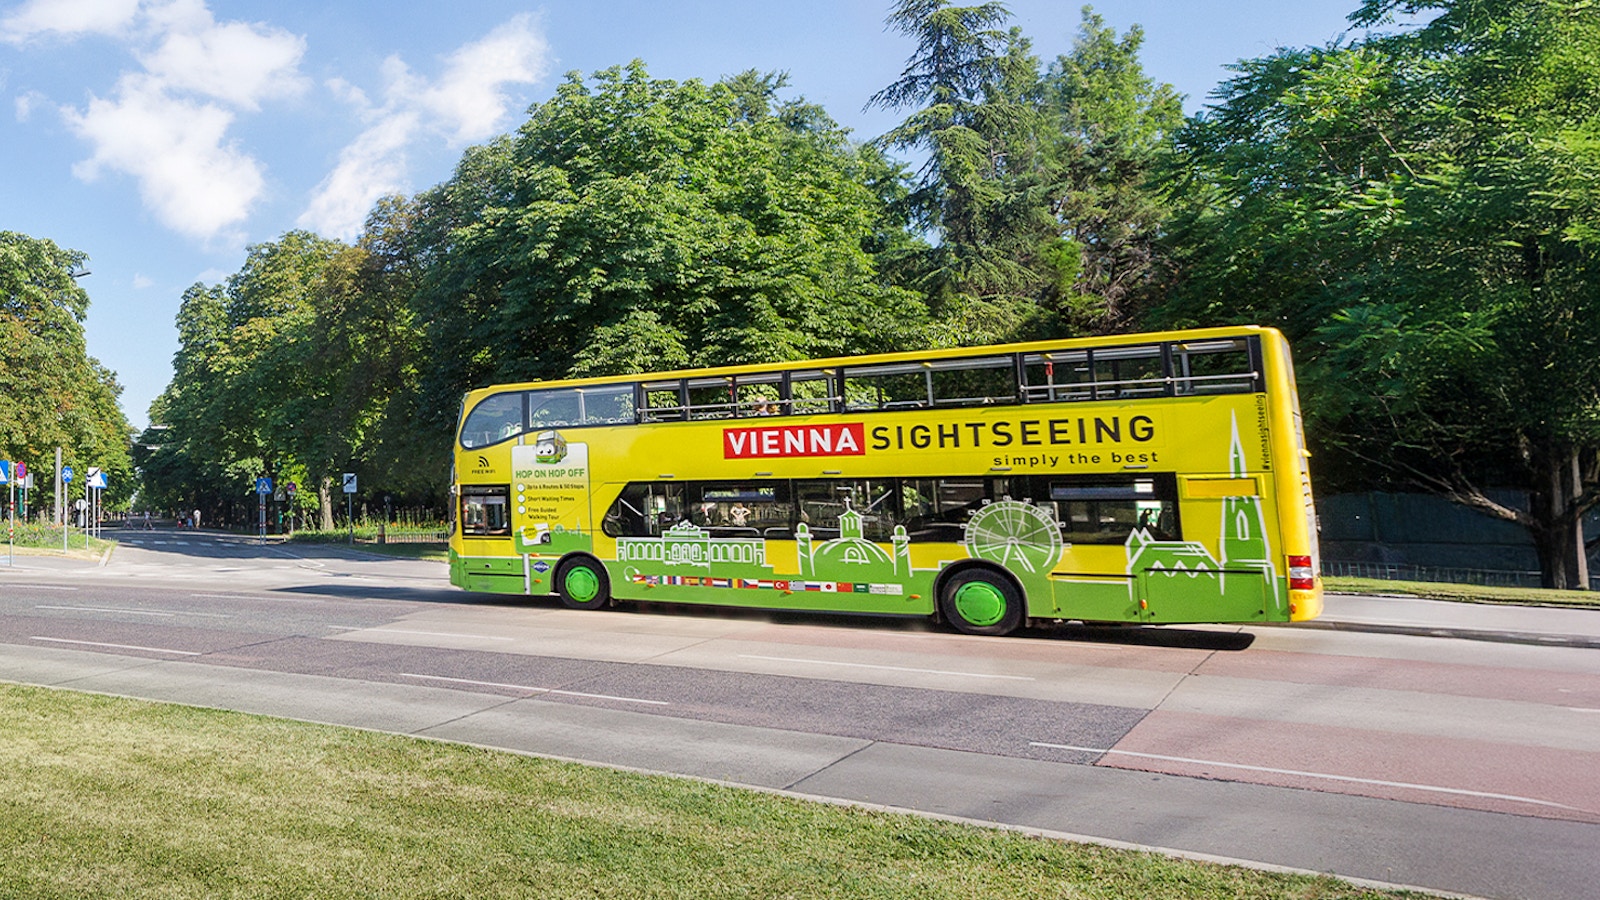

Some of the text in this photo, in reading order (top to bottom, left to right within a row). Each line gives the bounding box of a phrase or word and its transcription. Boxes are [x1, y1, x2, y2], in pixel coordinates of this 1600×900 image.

[727, 415, 1155, 455] VIENNA SIGHTSEEING
[993, 452, 1158, 468] simply the best
[516, 468, 585, 478] HOP ON HOP OFF
